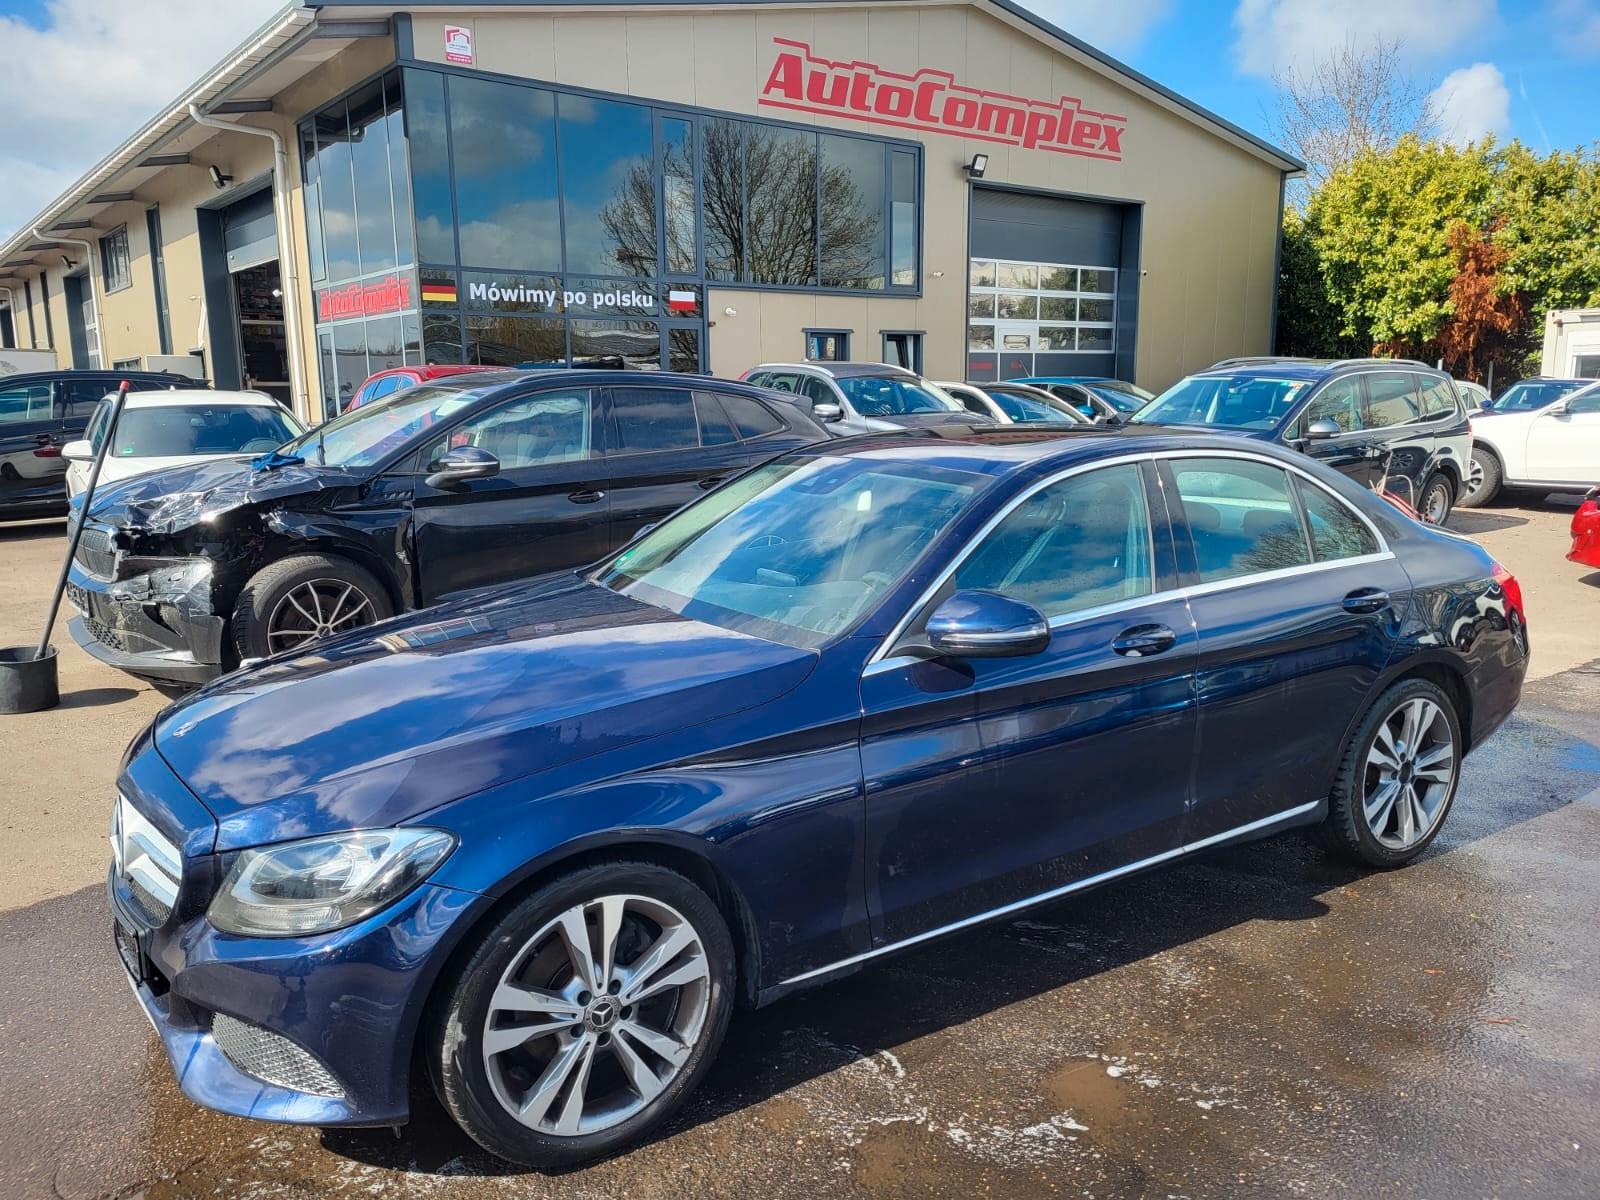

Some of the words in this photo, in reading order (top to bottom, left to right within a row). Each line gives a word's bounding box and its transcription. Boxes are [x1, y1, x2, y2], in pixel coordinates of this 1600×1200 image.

[763, 52, 1125, 150] AutoComplex
[469, 282, 556, 307] Mówimy
[563, 290, 587, 307] po
[593, 289, 653, 308] polsku
